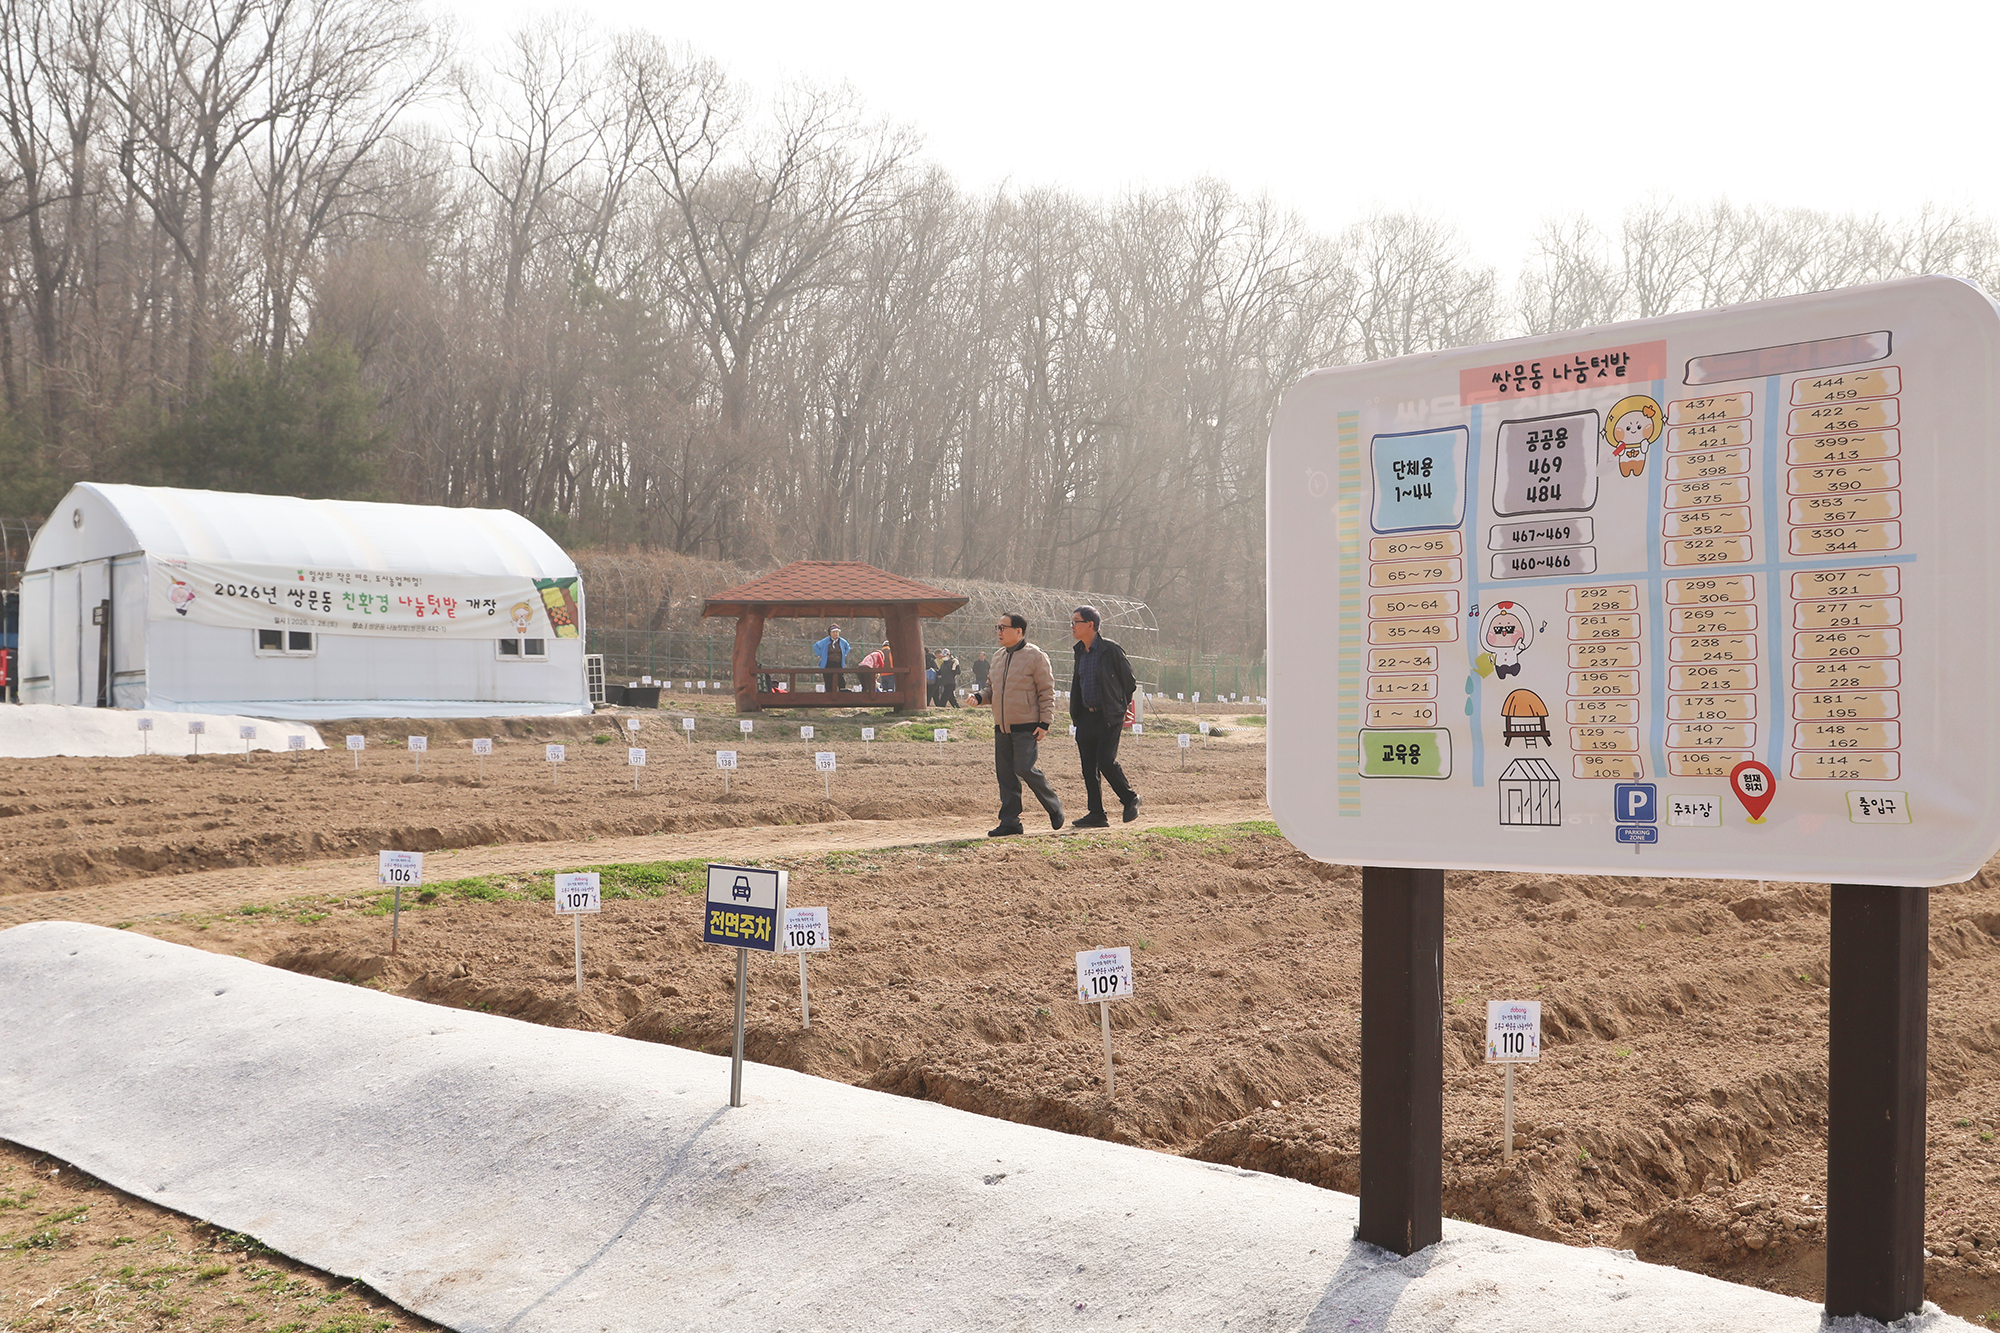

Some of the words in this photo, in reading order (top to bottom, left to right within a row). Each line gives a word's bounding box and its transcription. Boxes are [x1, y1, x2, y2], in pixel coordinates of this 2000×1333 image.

[1492, 363, 1543, 392] 쌍문동
[1553, 352, 1630, 383] 나눔텃밭
[1813, 378, 1843, 388] 444
[1825, 390, 1857, 400] 459
[1686, 399, 1714, 409] 437
[1697, 411, 1726, 420] 444
[1811, 408, 1842, 417] 422
[1825, 420, 1858, 430] 436
[1688, 426, 1716, 435] 414
[1526, 428, 1568, 452] 공공용
[1699, 438, 1727, 447] 421
[1687, 454, 1714, 464] 391
[1825, 451, 1858, 460] 413
[1393, 457, 1433, 480] 단체용
[1529, 456, 1562, 475] 469
[1699, 466, 1726, 476] 398
[1813, 468, 1846, 478] 376
[1682, 483, 1709, 492] 368
[1828, 481, 1861, 491] 390
[1395, 483, 1432, 502] 1~44
[1527, 484, 1561, 503] 484
[1693, 494, 1722, 504] 375
[1810, 498, 1842, 508] 353
[1681, 513, 1710, 522] 345
[1824, 511, 1856, 521] 367
[1513, 527, 1570, 542] 467~469
[1693, 525, 1722, 535] 352
[1812, 528, 1844, 538] 330
[1389, 541, 1443, 553] 80~95
[1684, 540, 1713, 549] 322
[1826, 542, 1857, 551] 344
[1697, 552, 1727, 561] 329
[1512, 555, 1570, 570] 460~466
[309, 570, 332, 582] 일상의
[337, 573, 350, 584] 작은
[1389, 569, 1442, 580] 65~79
[1814, 573, 1846, 582] 307
[1687, 581, 1715, 590] 299
[1581, 589, 1607, 597] 292
[1828, 586, 1858, 595] 321
[215, 583, 277, 605] 2026년
[287, 590, 332, 612] 쌍문동
[342, 592, 389, 615] 친환경
[398, 594, 458, 619] 나눔텃밭
[466, 598, 497, 616] 개장
[1699, 594, 1729, 603] 306
[1387, 600, 1438, 611] 50~64
[1593, 602, 1619, 610] 298
[1817, 604, 1847, 612] 277
[1685, 610, 1713, 619] 269
[1581, 617, 1607, 625] 261
[1831, 617, 1860, 626] 291
[1388, 626, 1440, 636] 35~49
[1698, 624, 1726, 632] 276
[1593, 629, 1619, 637] 268
[1816, 633, 1846, 642] 246
[1691, 639, 1719, 647] 238
[1704, 652, 1733, 660] 245
[1830, 647, 1859, 656] 260
[1379, 657, 1431, 667] 22~34
[1689, 668, 1717, 676] 206
[1817, 664, 1847, 673] 214
[1582, 673, 1608, 681] 196
[1701, 681, 1730, 689] 213
[1830, 678, 1859, 686] 228
[1377, 683, 1428, 692] 11~21
[1593, 686, 1620, 694] 205
[1813, 695, 1842, 703] 181
[1578, 702, 1606, 710] 163
[1697, 711, 1726, 719] 180
[1827, 709, 1856, 717] 195
[1684, 724, 1712, 732] 140
[1816, 726, 1845, 734] 148
[1829, 739, 1857, 747] 162
[1383, 744, 1421, 764] 교육용
[1683, 754, 1709, 762] 106
[1594, 770, 1621, 778] 105
[1743, 774, 1761, 782] 현재
[1828, 770, 1859, 779] 128
[1745, 783, 1762, 791] 위치
[1628, 790, 1648, 816] P
[1860, 797, 1896, 815] 출입구
[1674, 803, 1712, 817] 주차장
[390, 869, 410, 881] 106
[567, 894, 588, 907] 107
[710, 910, 771, 941] 전면주차
[789, 930, 816, 946] 108
[1092, 974, 1118, 995] 109
[1502, 1032, 1524, 1053] 110
